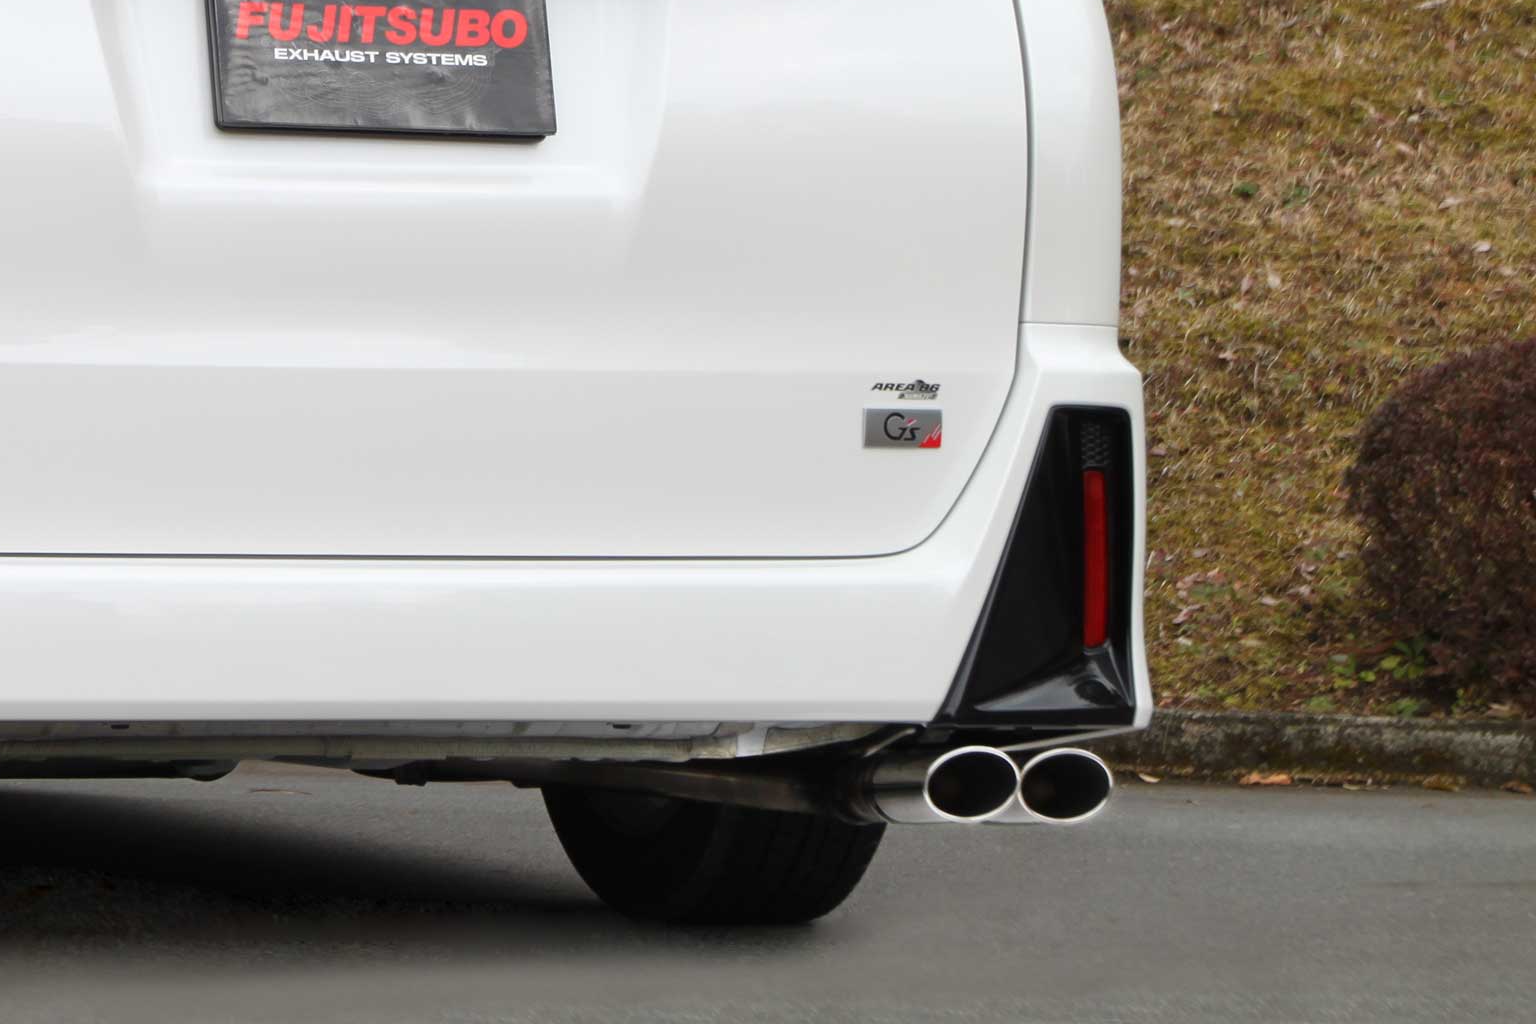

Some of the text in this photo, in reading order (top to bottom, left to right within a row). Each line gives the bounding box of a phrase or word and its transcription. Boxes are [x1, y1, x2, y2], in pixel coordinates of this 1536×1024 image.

[234, 1, 529, 49] FUJITSUBO
[274, 48, 488, 67] EXHAUST SYSTEMS
[871, 382, 915, 392] AREA
